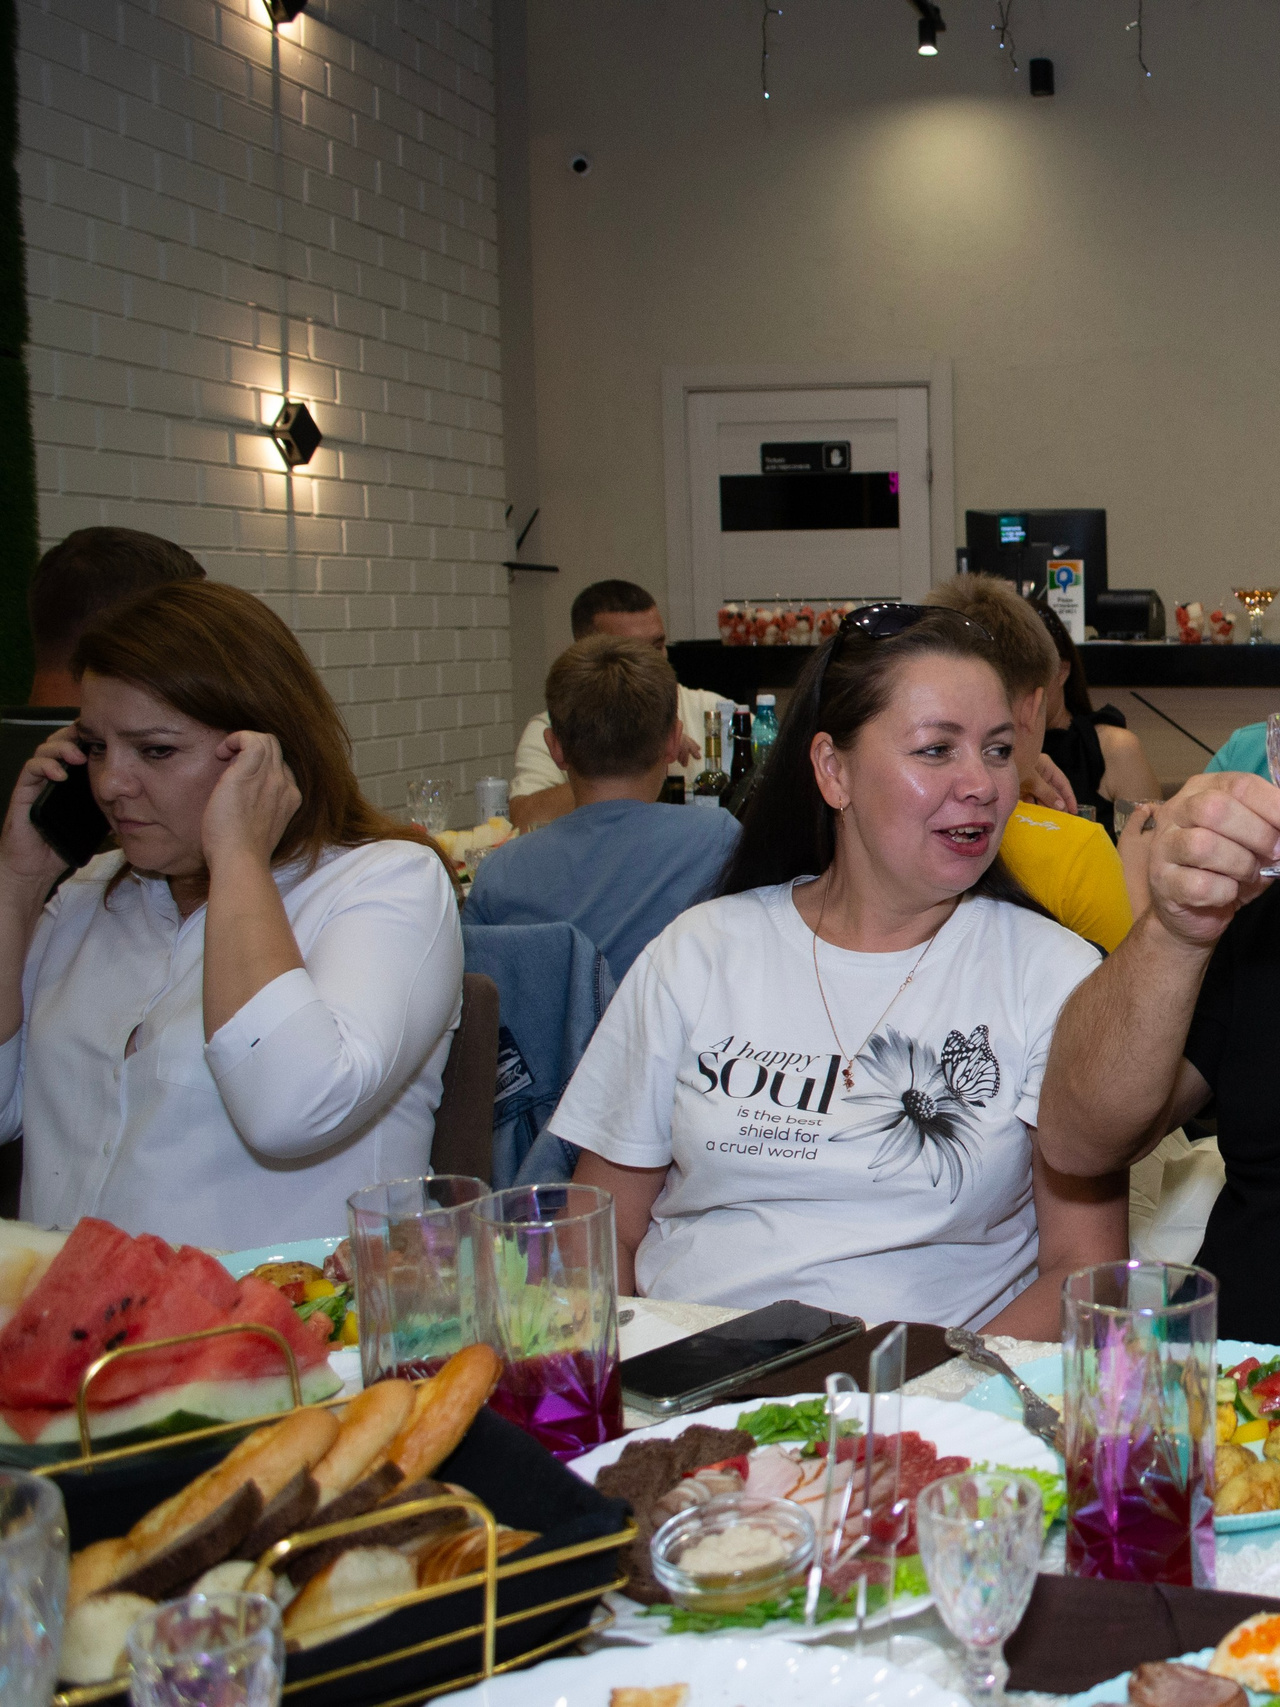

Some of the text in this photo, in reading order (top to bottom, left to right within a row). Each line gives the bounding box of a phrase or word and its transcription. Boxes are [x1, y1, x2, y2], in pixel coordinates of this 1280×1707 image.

[709, 1035, 820, 1073] A happy
[698, 1051, 842, 1115] soul
[737, 1105, 823, 1126] is the best
[739, 1124, 820, 1143] shield for
[705, 1140, 818, 1160] a cruel world
